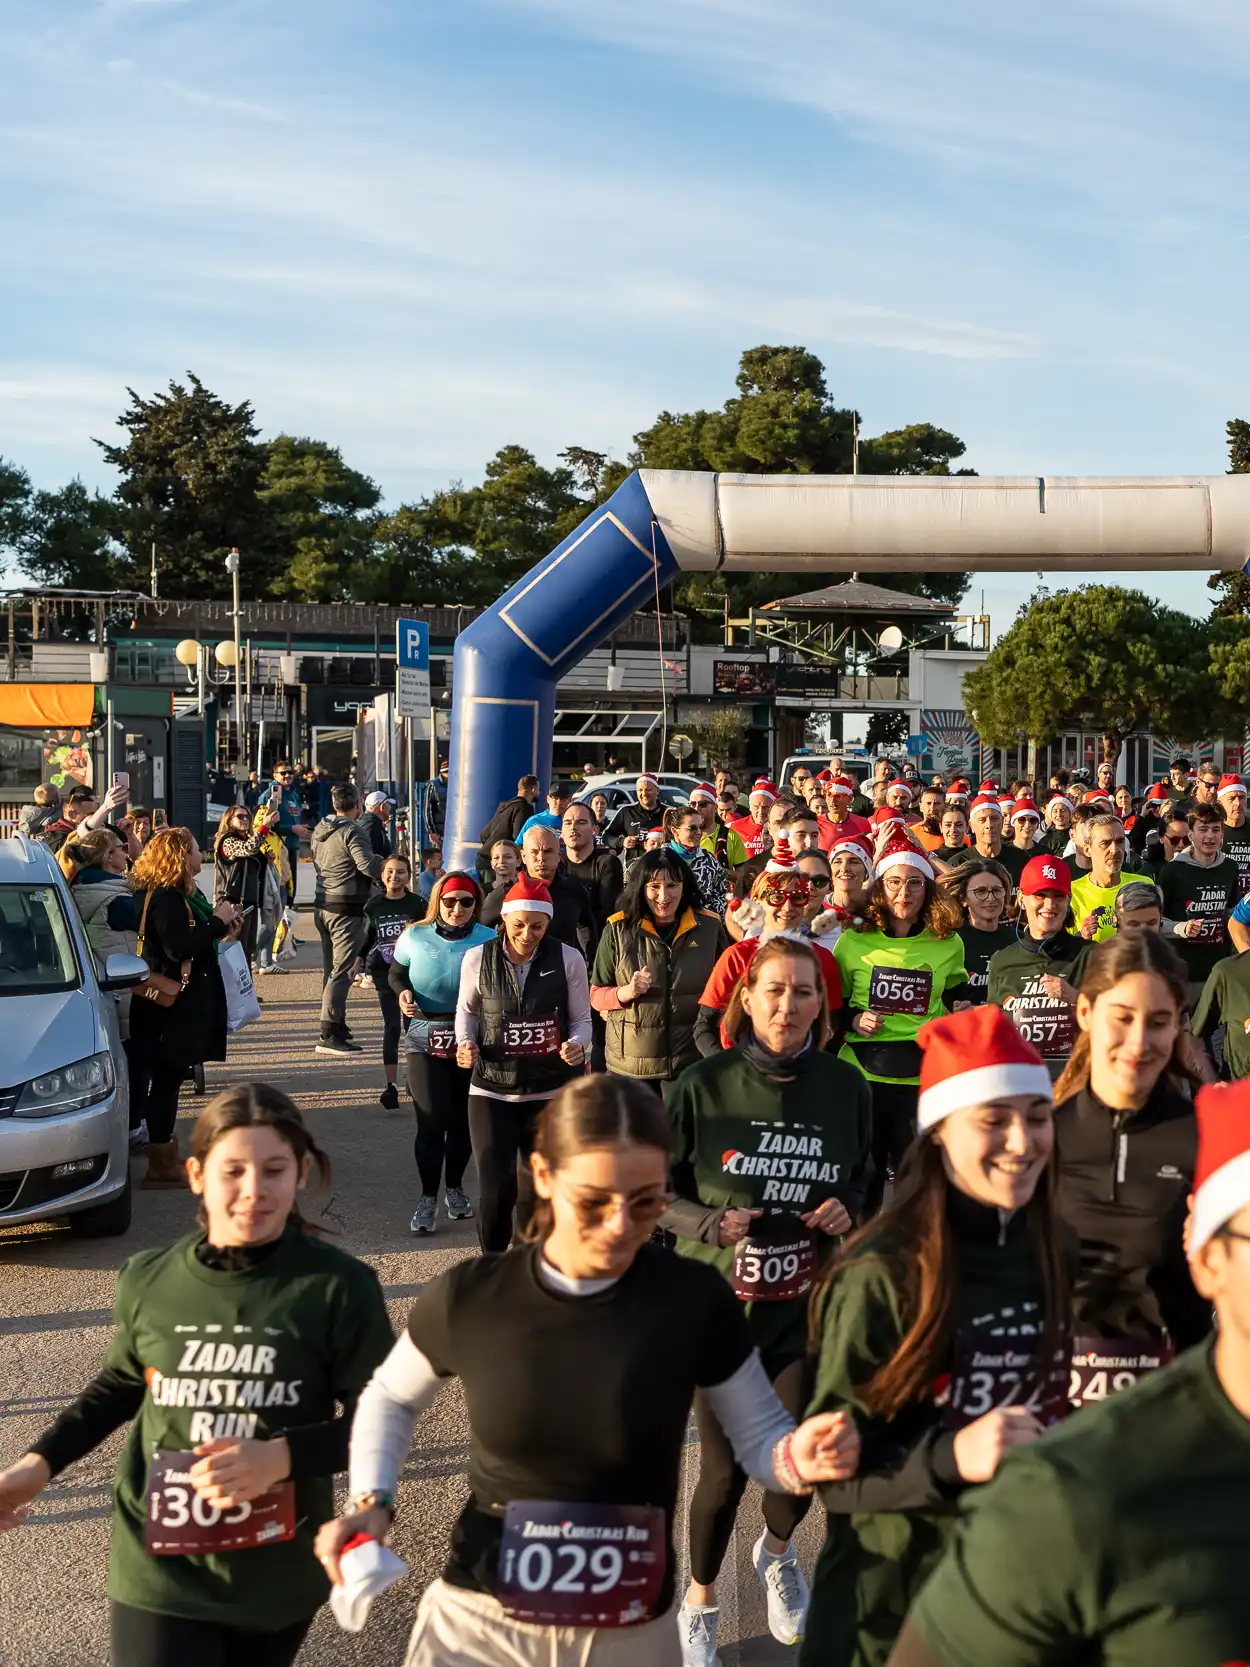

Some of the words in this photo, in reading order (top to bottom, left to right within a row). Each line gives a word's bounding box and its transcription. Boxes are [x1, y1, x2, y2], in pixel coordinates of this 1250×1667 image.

[406, 629, 420, 659] P
[717, 663, 750, 673] Rooftop
[1201, 890, 1226, 901] ZADAR
[1200, 923, 1217, 936] 57
[876, 981, 915, 1001] 056
[1022, 981, 1047, 995] ZAD
[434, 1036, 455, 1049] 27
[508, 1028, 546, 1046] 323
[1020, 1023, 1058, 1042] 057
[757, 1131, 823, 1157] ZADAR
[727, 1151, 840, 1183] CHRISTMAS
[762, 1180, 812, 1203] RUN
[742, 1254, 799, 1283] 309
[177, 1340, 277, 1374] ZADAR
[151, 1371, 303, 1408] CHRISTMAS
[190, 1411, 258, 1442] RUN
[517, 1542, 623, 1594] 029
